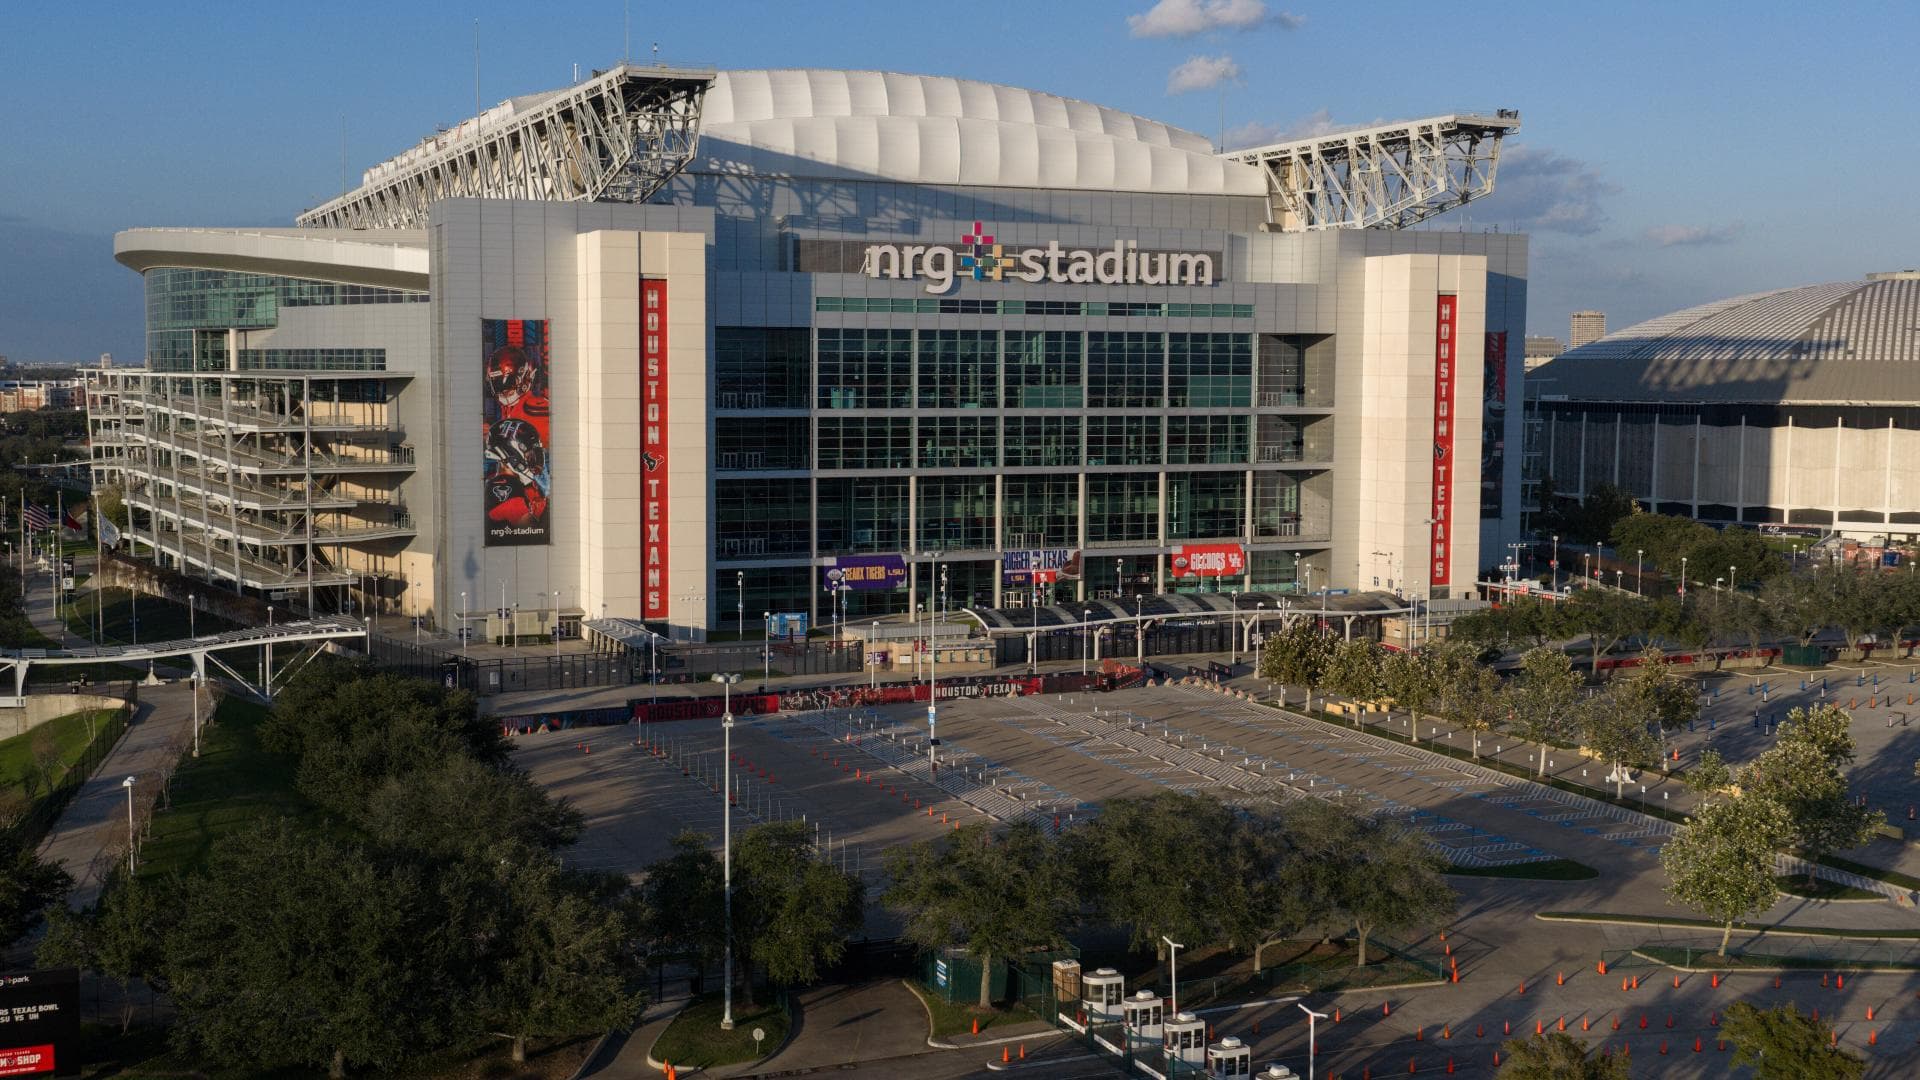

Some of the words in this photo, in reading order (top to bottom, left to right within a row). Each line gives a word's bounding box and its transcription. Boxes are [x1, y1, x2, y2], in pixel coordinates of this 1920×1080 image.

[869, 244, 953, 294] nrg
[1019, 239, 1213, 285] stadium
[647, 289, 659, 444] HOUSTON
[1438, 303, 1450, 437] HOUSTON
[491, 528, 504, 537] nrg
[513, 526, 544, 535] stadium
[1435, 466, 1446, 577] TEXANS
[648, 480, 660, 610] TEXANS
[1004, 551, 1030, 570] BIGGER
[1043, 550, 1068, 569] TEXAS
[846, 567, 864, 580] GEAUX
[866, 566, 885, 580] TIGERS
[935, 686, 978, 698] HOUSTON
[987, 683, 1023, 694] TEXANS
[648, 702, 702, 722] HOUSTON
[12, 976, 30, 984] park
[12, 1006, 37, 1014] TEXAS
[38, 1004, 59, 1012] BOWL
[17, 1054, 41, 1065] SHOP
